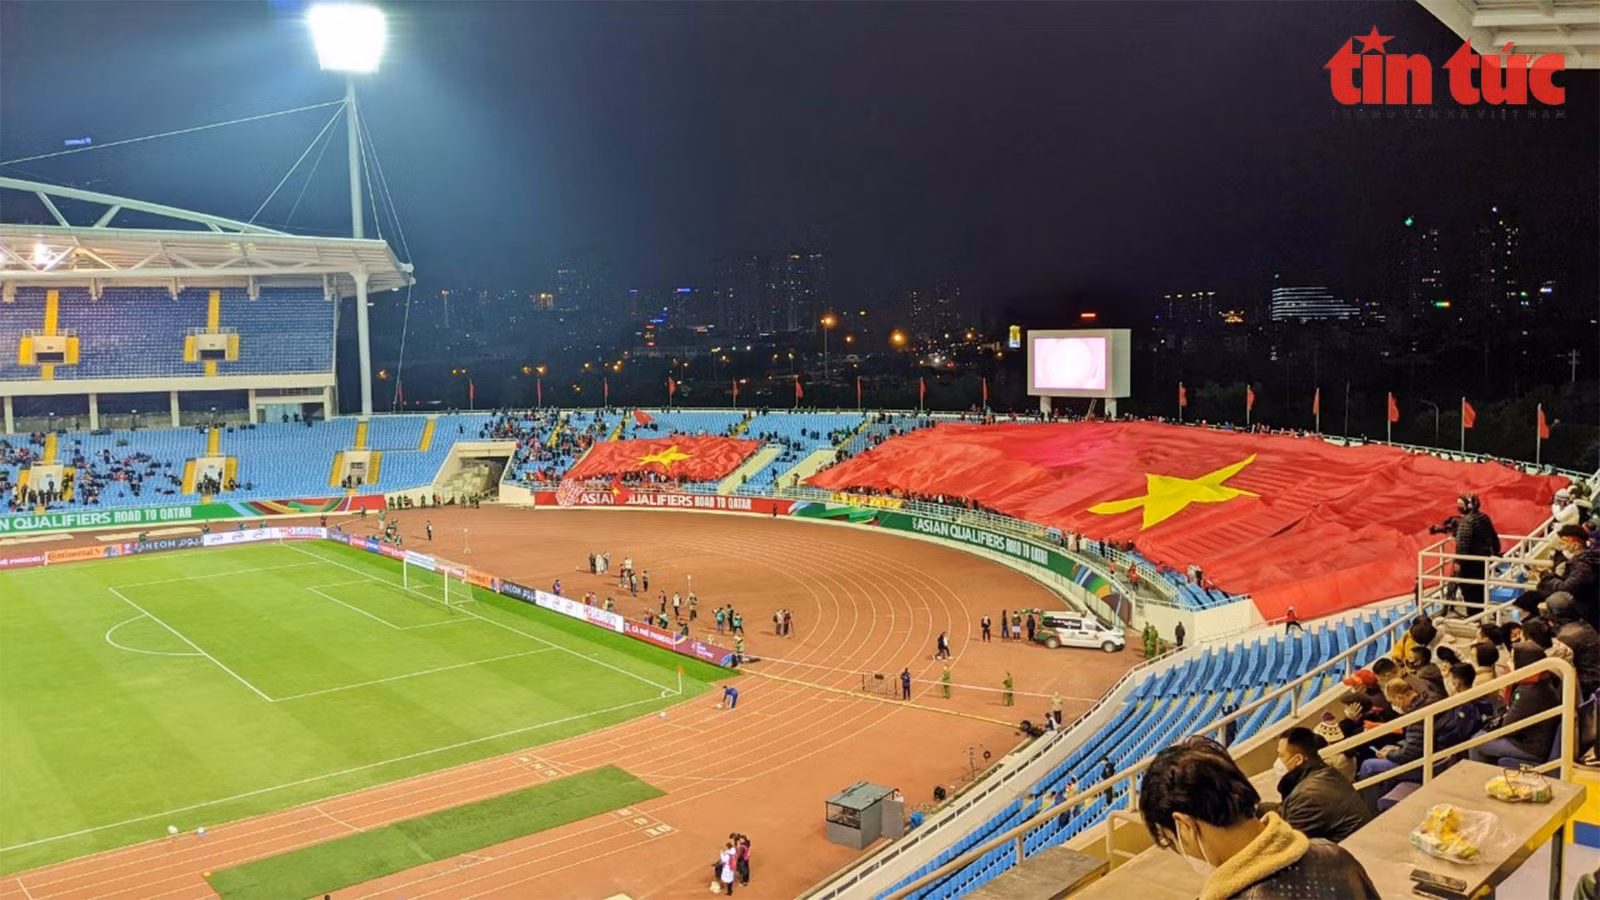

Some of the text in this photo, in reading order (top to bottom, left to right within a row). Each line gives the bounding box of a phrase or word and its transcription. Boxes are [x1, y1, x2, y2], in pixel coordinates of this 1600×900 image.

[625, 493, 692, 506] UALIFIERS
[13, 512, 111, 529] QUALIFIERS
[114, 510, 141, 523] ROAD
[144, 508, 157, 521] TO
[160, 506, 192, 520] QATAR
[917, 518, 949, 536] ASIAN
[950, 524, 1005, 550] QUALIFIERS
